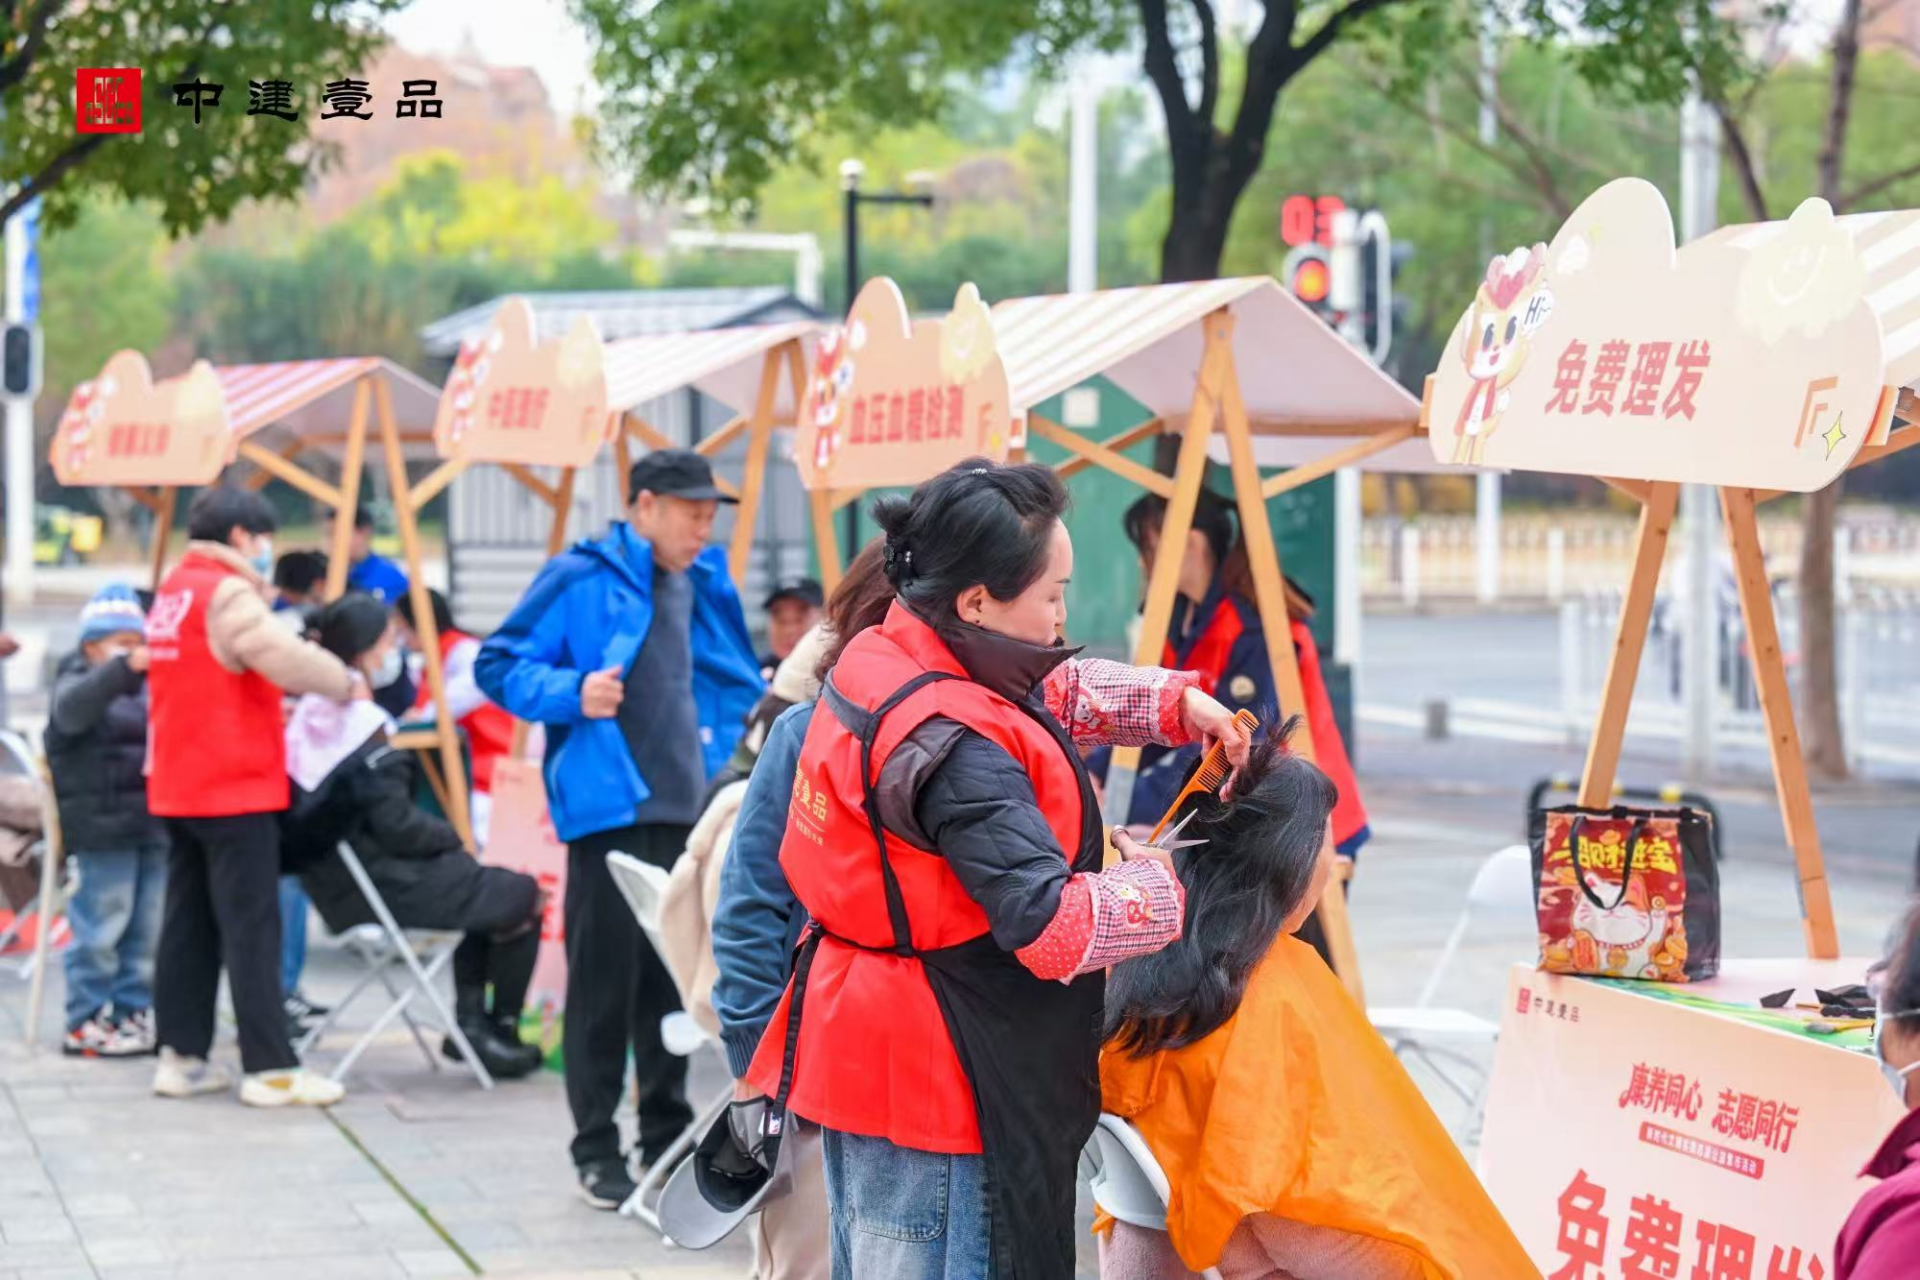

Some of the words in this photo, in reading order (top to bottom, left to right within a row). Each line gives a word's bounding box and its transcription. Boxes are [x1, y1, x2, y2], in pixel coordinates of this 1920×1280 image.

[849, 384, 964, 444] 血压血糖检测
[1543, 338, 1711, 421] 免费理发
[1548, 836, 1678, 875] 招财进宝
[1618, 1062, 1703, 1121] 康养同心
[1711, 1088, 1799, 1153] 志愿同行
